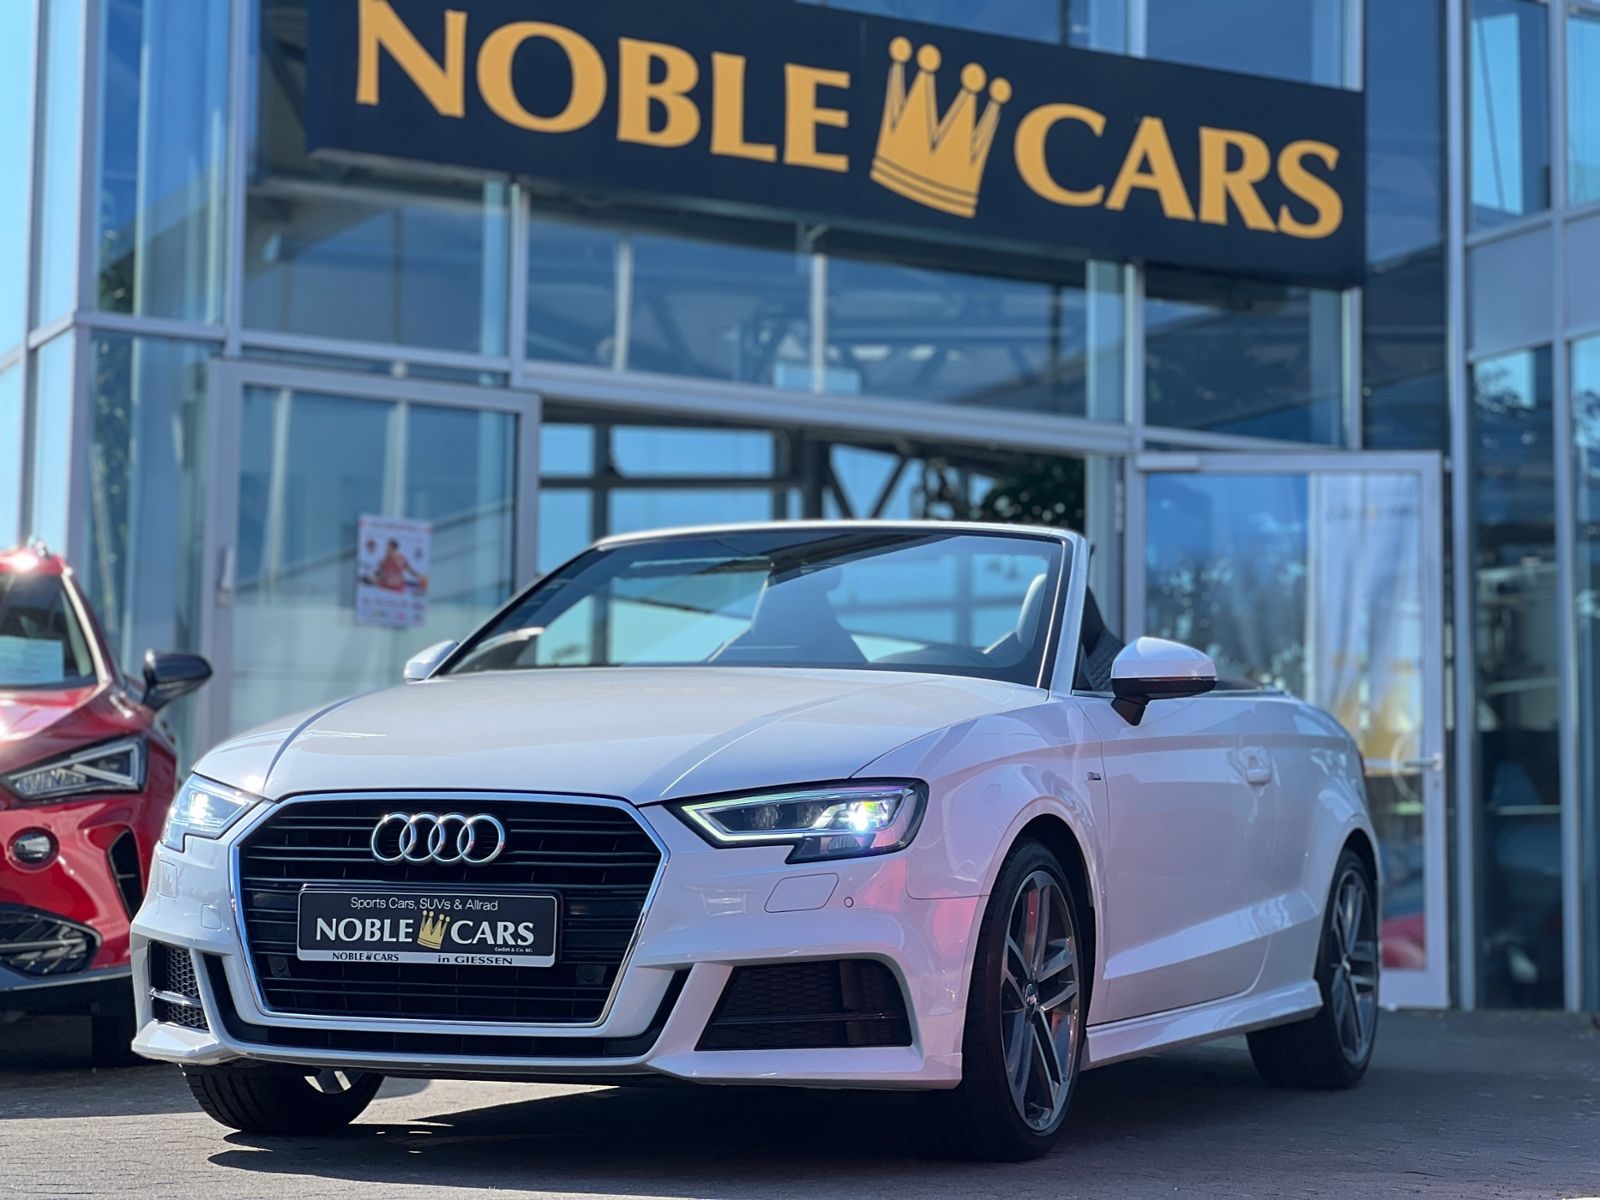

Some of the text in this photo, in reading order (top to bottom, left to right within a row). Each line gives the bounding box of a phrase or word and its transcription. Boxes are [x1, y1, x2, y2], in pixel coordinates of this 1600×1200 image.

[355, 0, 1343, 238] NOBLE CARS
[350, 896, 499, 911] Sports Cars, SUVs & Allrad
[316, 917, 535, 946] NOBLE CARS
[332, 952, 400, 961] NOBLE CARS
[437, 954, 513, 965] in GIESSEN
